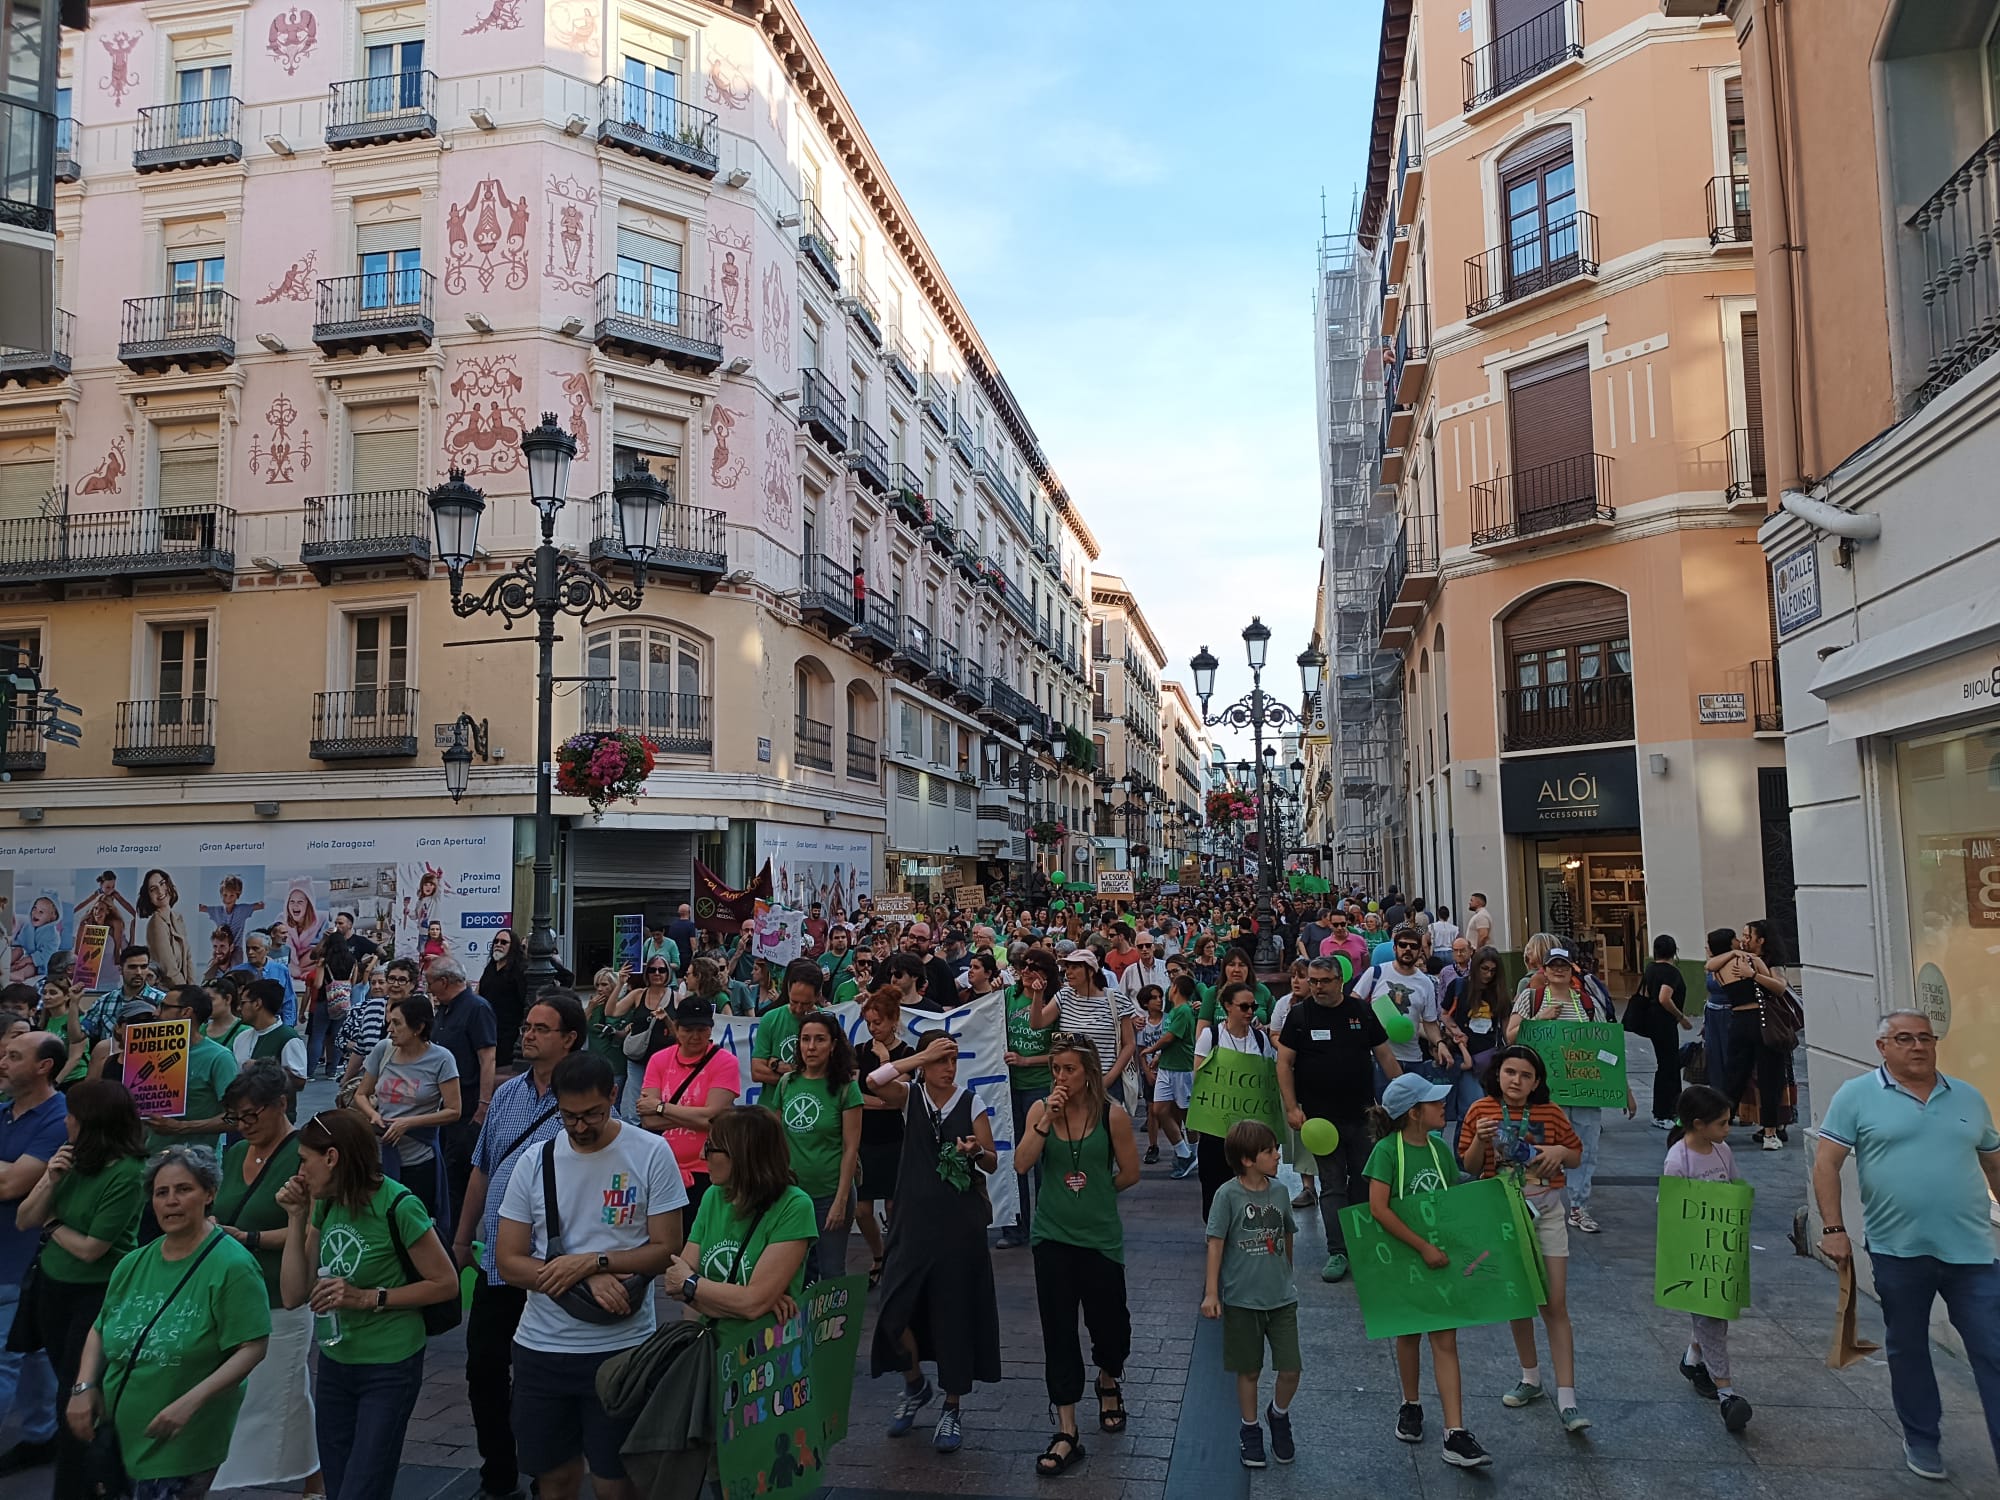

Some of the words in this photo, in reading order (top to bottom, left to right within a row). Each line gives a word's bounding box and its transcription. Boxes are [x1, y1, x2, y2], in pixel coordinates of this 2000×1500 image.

[1789, 555, 1813, 583] CALLE
[1781, 586, 1812, 617] ALFONSO
[1963, 677, 1990, 700] BIJOU
[1715, 695, 1743, 703] CALLE
[1539, 809, 1598, 819] ACCESSORIES
[199, 843, 223, 853] ¡Gran
[224, 842, 265, 852] Apertura!
[306, 840, 330, 850] ¡Hola
[331, 839, 375, 850] Zaragoza!
[416, 837, 441, 847] ¡Gran
[443, 836, 486, 847] Apertura!
[18, 846, 56, 856] Apertura!
[97, 845, 118, 854] ¡Hola
[119, 844, 161, 855] Zaragoza!
[460, 872, 501, 882] ¡Proxima
[456, 885, 501, 896] apertura!
[465, 915, 504, 928] pepco
[133, 1023, 185, 1040] DINERO
[1520, 1024, 1557, 1041] NUESTRO
[129, 1037, 186, 1054] PÚBLICO
[1560, 1046, 1594, 1062] VENDE
[138, 1084, 158, 1092] PARA
[135, 1089, 179, 1101] DUCACIÓN
[612, 1172, 629, 1189] BE
[603, 1186, 636, 1207] YOUR
[743, 1361, 775, 1396] PAGO
[815, 1315, 848, 1346] QUE
[744, 1396, 768, 1428] ME
